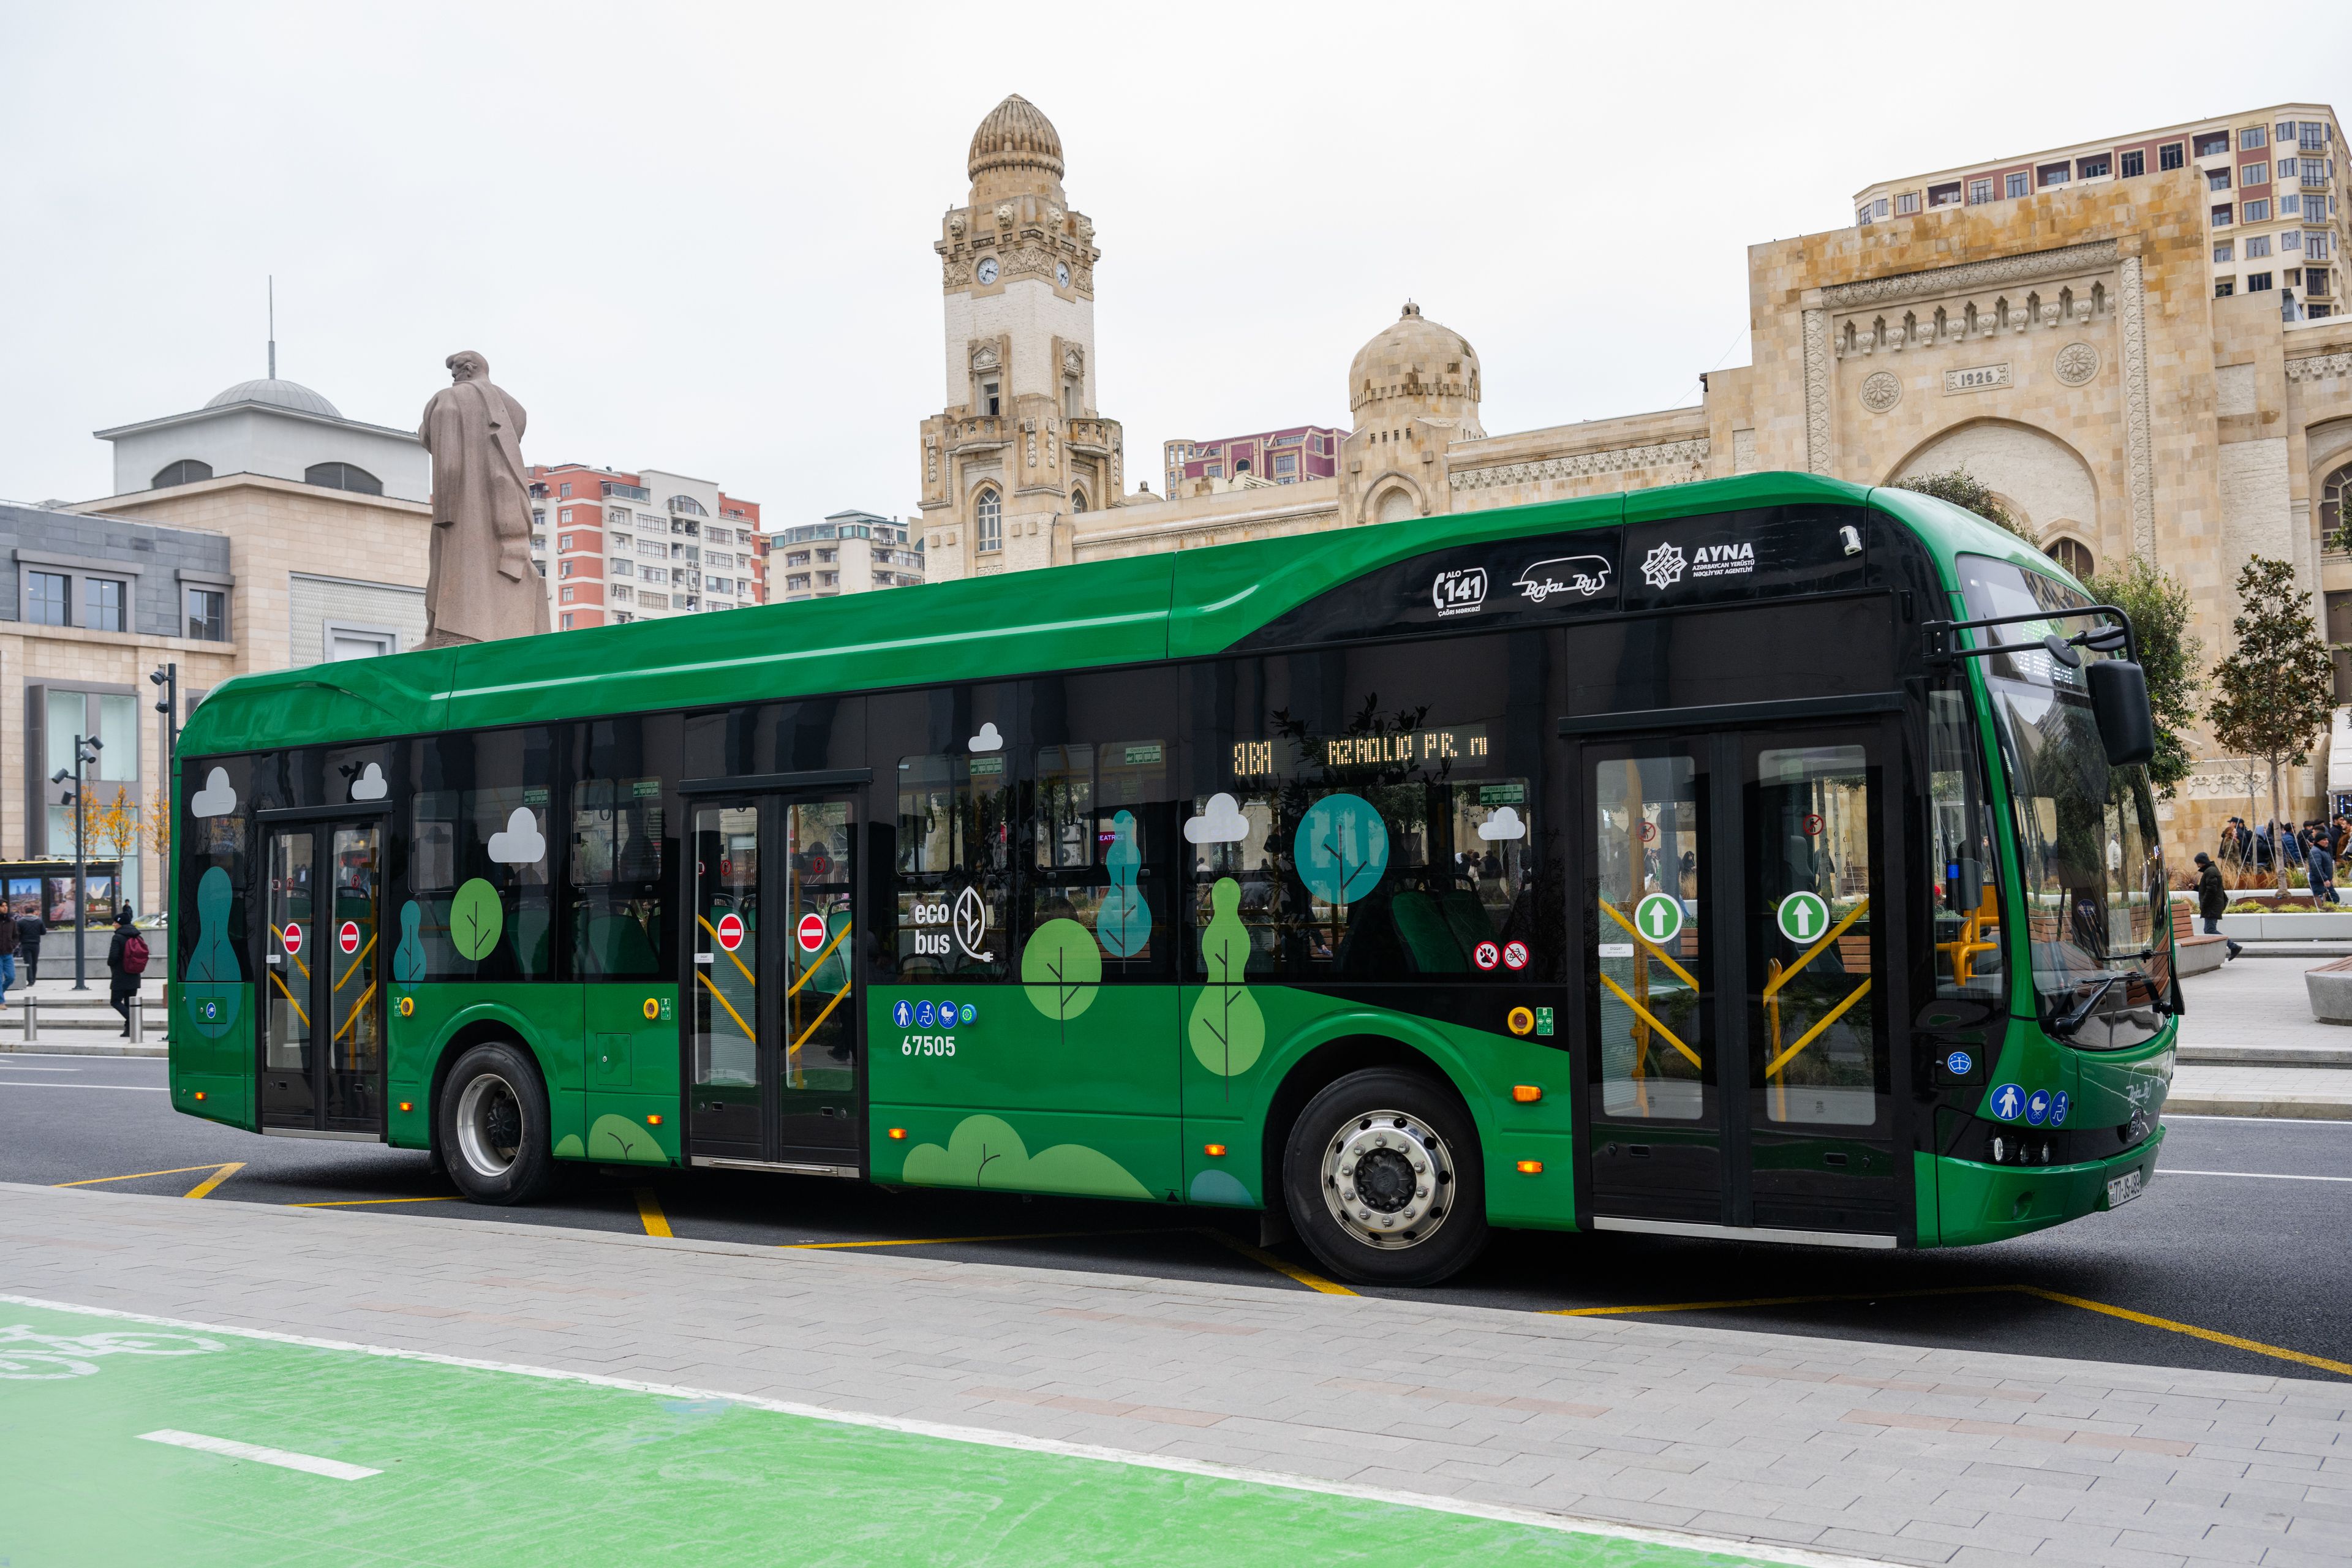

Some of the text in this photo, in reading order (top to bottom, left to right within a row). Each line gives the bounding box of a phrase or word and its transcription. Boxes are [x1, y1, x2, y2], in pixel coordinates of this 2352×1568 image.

[1961, 371, 1992, 386] 1926
[1693, 543, 1754, 564] AYNA
[1446, 570, 1461, 579] ALO
[1444, 576, 1481, 602] 141
[1438, 605, 1480, 617] ÇAĞRI MƏRKƏZİ
[914, 903, 949, 924] eco
[915, 929, 951, 954] bus
[902, 1035, 956, 1057] 67505
